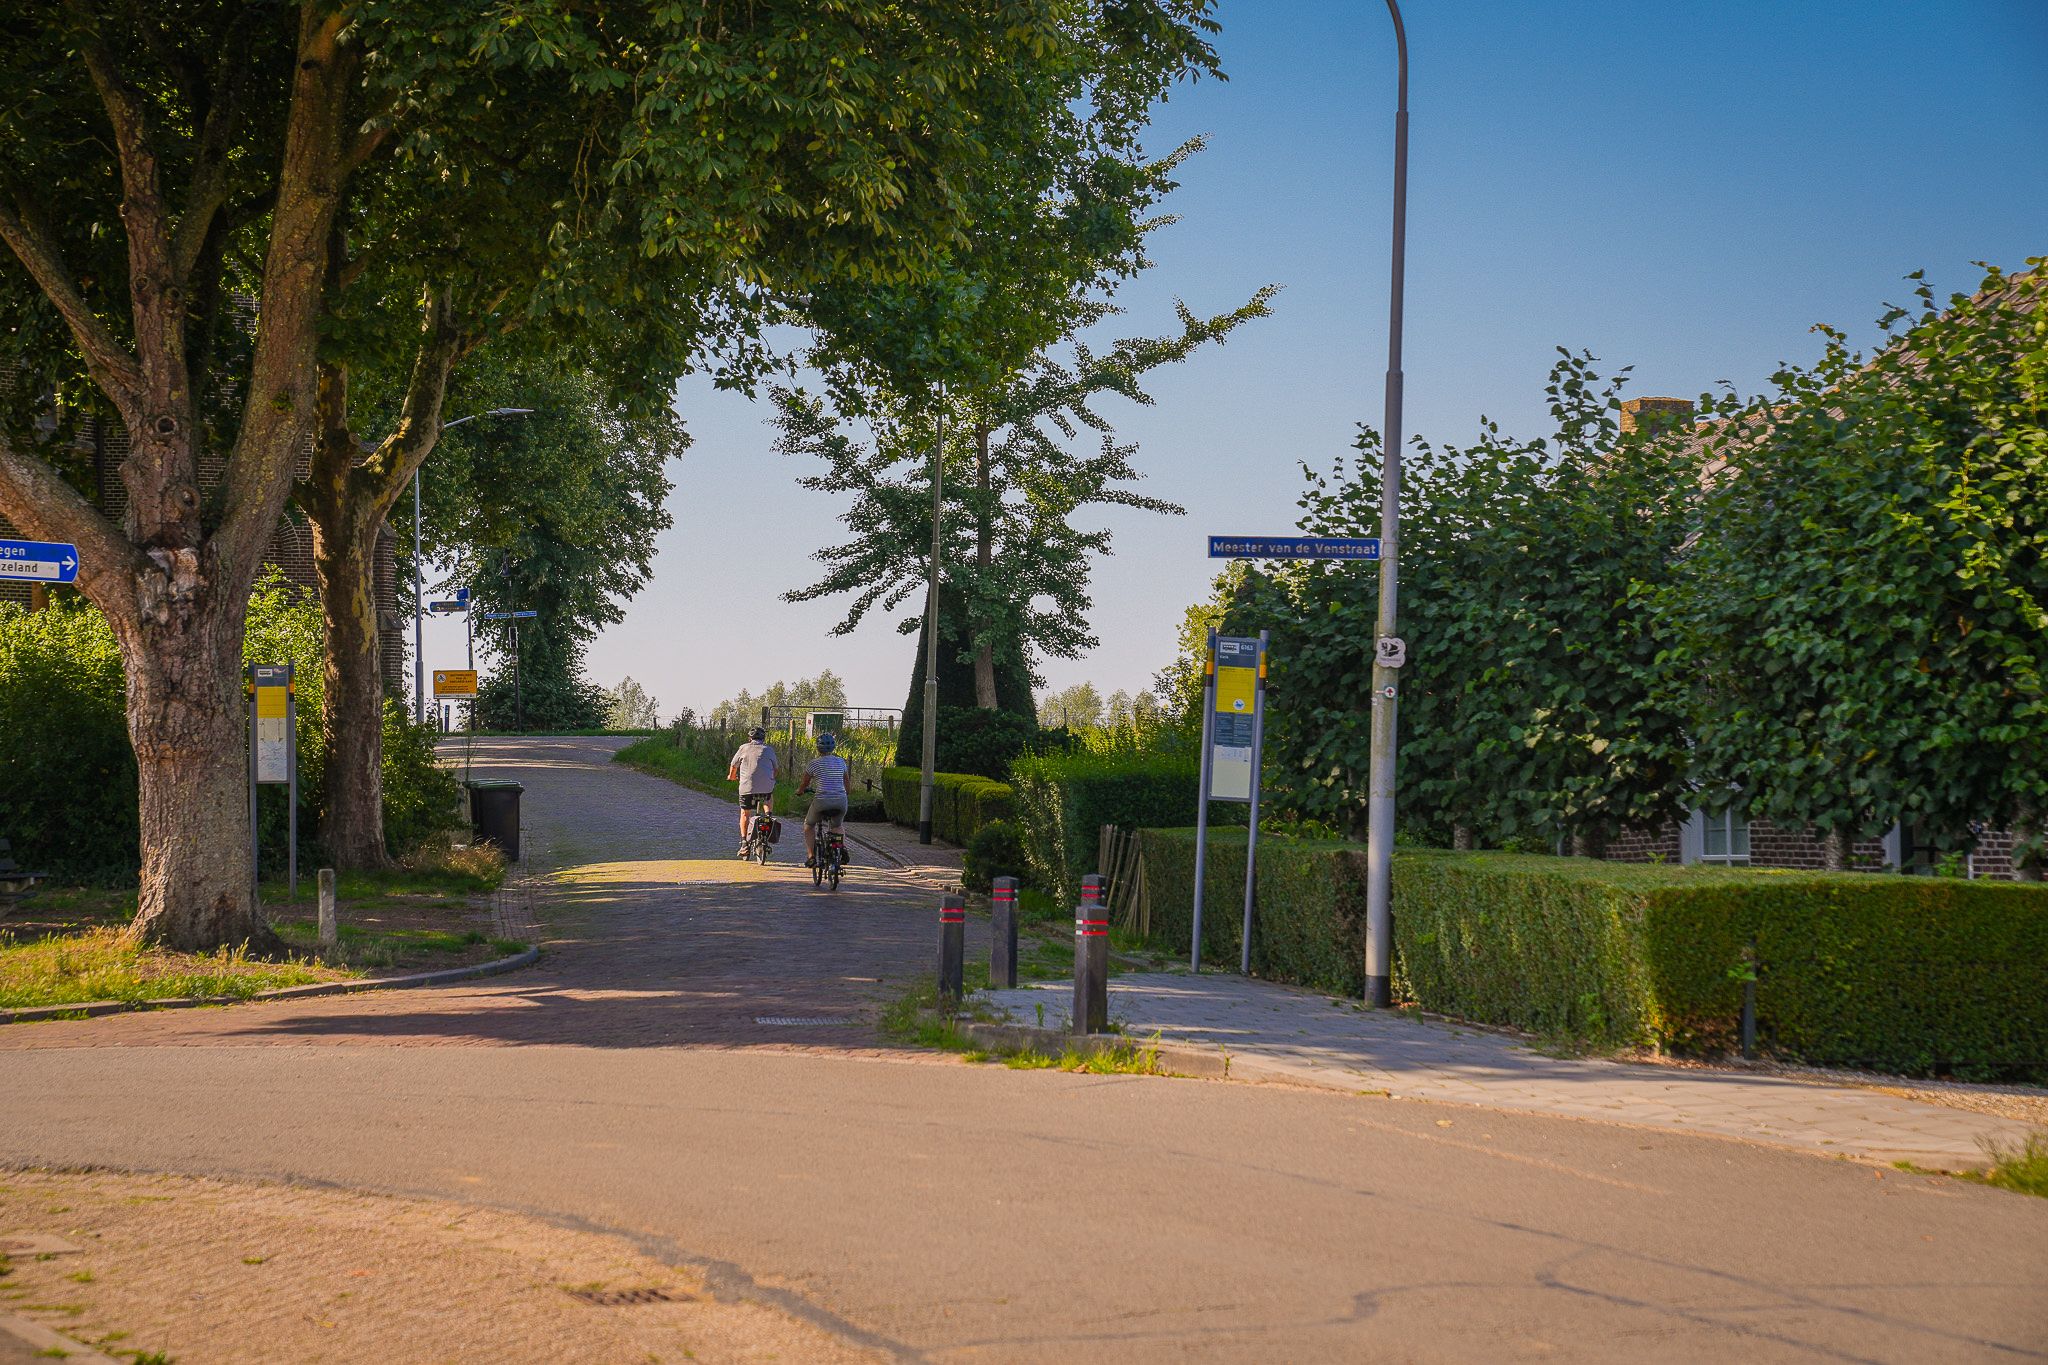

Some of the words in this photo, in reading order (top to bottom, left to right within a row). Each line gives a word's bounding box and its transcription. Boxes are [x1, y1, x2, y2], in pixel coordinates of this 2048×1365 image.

[1214, 541, 1263, 553] Meester
[1268, 544, 1291, 553] van
[1295, 543, 1310, 553] de
[1315, 543, 1377, 554] Venstraat
[1, 561, 38, 573] zeland
